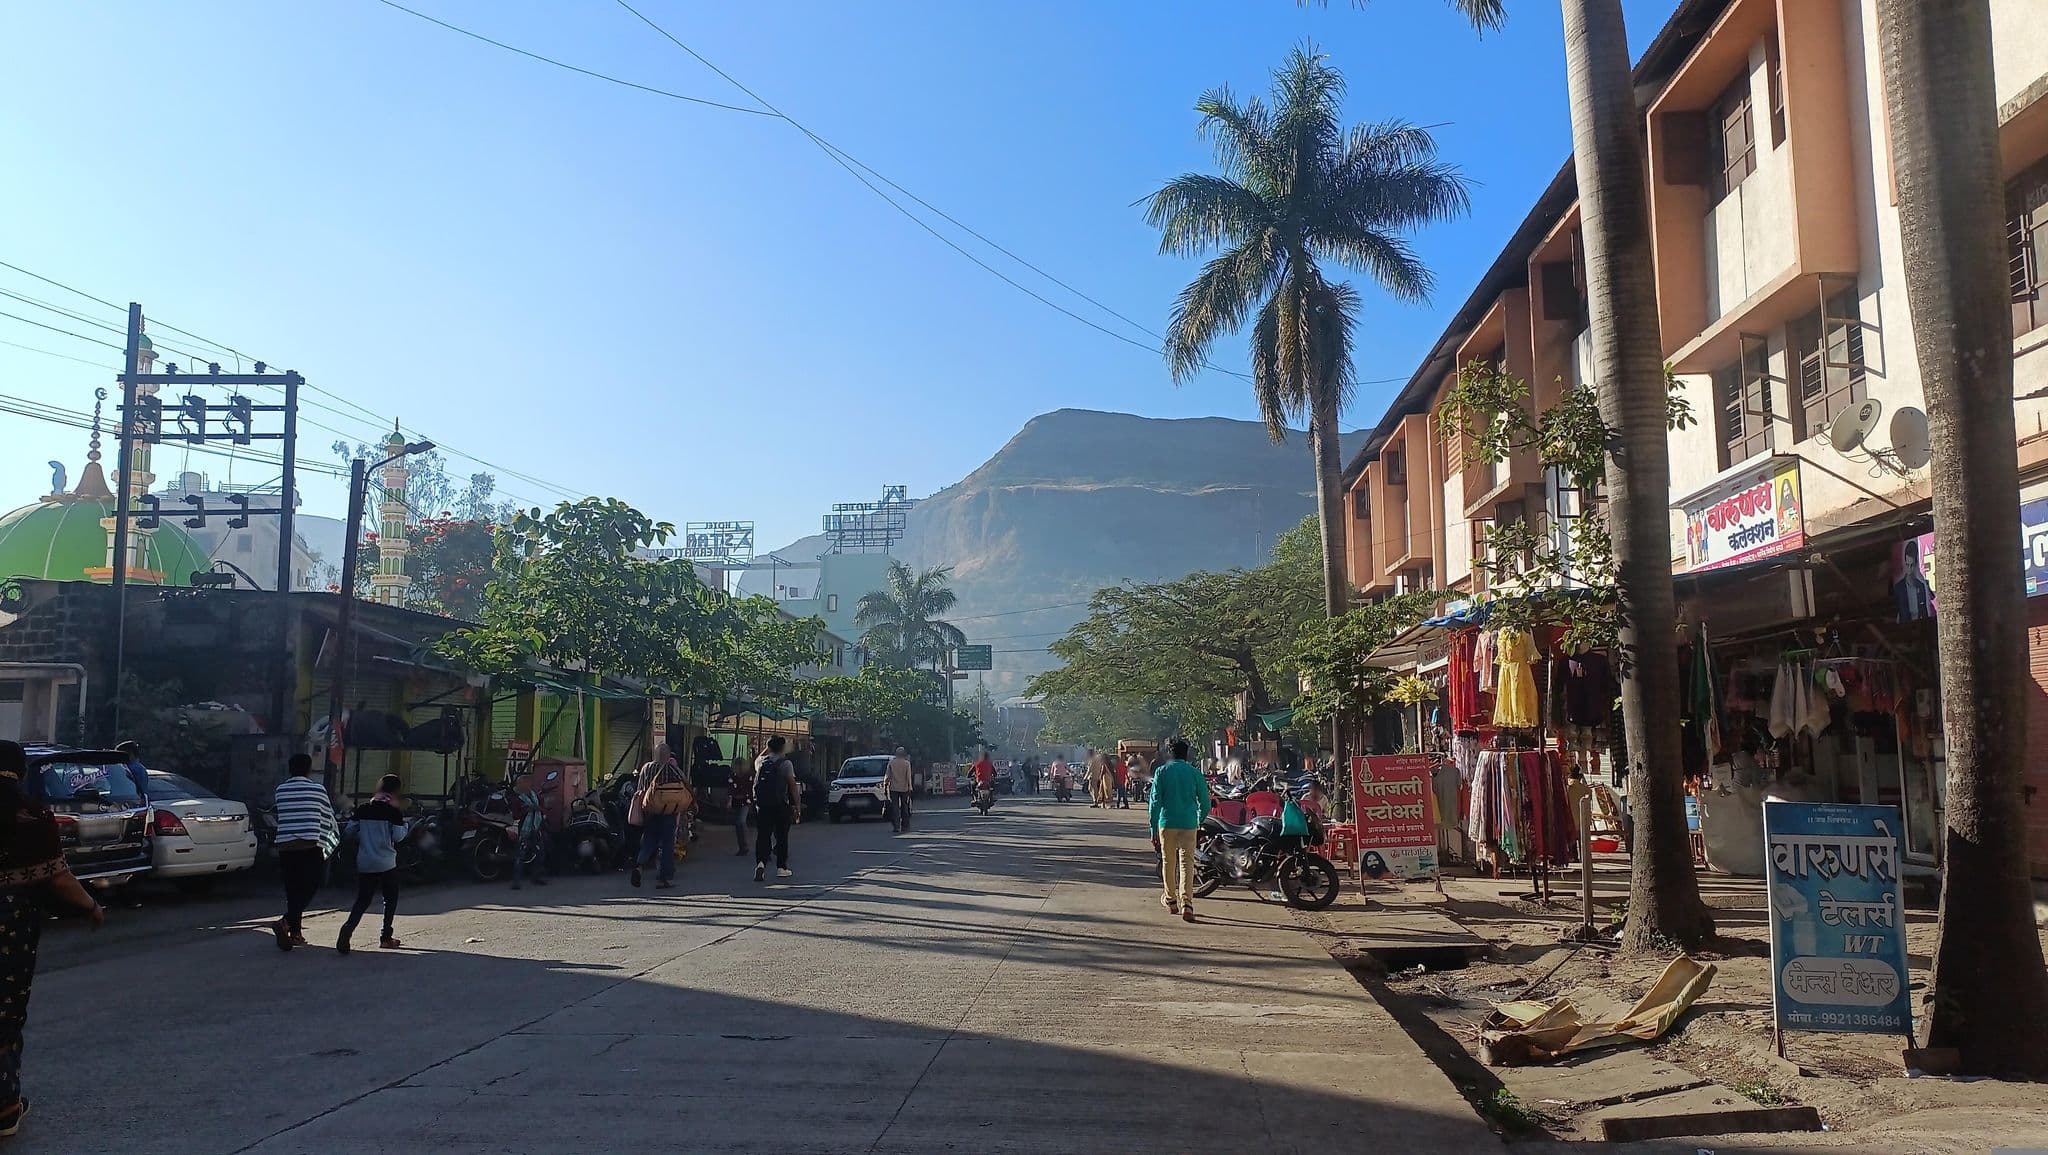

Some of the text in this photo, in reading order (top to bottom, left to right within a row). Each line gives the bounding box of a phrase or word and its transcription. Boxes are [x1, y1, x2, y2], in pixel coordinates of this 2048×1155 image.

[1728, 518, 1775, 551] कलेक्शन
[1361, 776, 1423, 797] पतंजली
[1364, 799, 1424, 821] स्टोअर्स
[1770, 819, 1898, 883] वारुणसे
[1818, 890, 1896, 928] टेलर्स
[1844, 934, 1885, 954] WT
[1789, 962, 1895, 998] मेन्स वेअर
[1821, 1012, 1901, 1027] 9921386484
